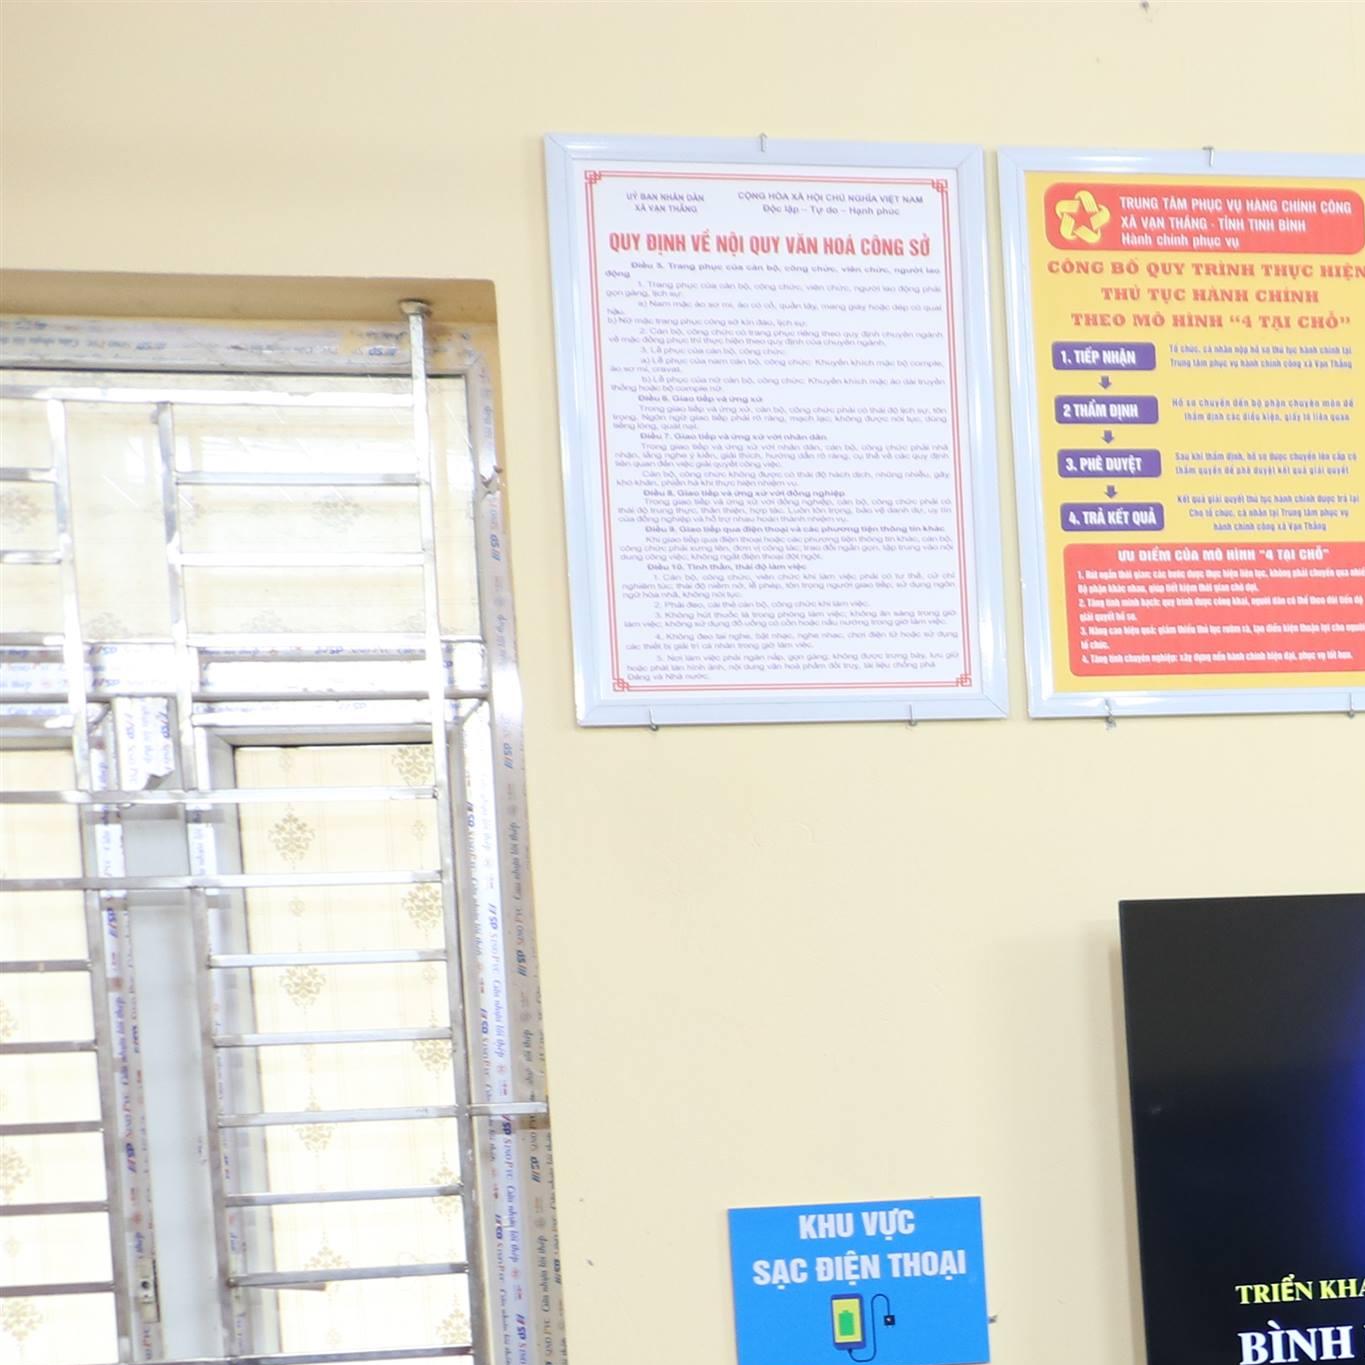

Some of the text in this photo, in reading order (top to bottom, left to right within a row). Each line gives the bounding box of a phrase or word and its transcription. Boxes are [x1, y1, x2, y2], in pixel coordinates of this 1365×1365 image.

[1119, 196, 1159, 211] TRUNG
[1162, 195, 1188, 211] TÂM
[1191, 198, 1223, 213] PHỤC
[1226, 198, 1243, 214] VỤ
[1281, 199, 1317, 214] CHÍNH
[1320, 199, 1352, 215] CÔNG
[609, 228, 930, 257] QUY ĐỊNH VỀ NỘI QUY VĂN HOÁ CÔNG SỞ
[1120, 233, 1240, 249] Hành chính phục vụ
[1047, 257, 1104, 275] CÔNG
[1110, 257, 1140, 275] BỐ
[1146, 261, 1185, 279] QUY
[1191, 260, 1255, 277] TRÌNH
[1260, 263, 1313, 281] THỰC
[1100, 284, 1319, 305] THỦ TỤC HÀNH CHÍNH
[1070, 312, 1126, 327] THEO
[1132, 311, 1166, 328] MÔ
[1172, 311, 1224, 329] HÌNH
[1258, 315, 1291, 332] TẠI
[1073, 346, 1100, 365] TIẾP
[1102, 347, 1136, 367] NHẬN
[1073, 398, 1108, 418] THẨM
[1109, 403, 1139, 421] ĐỊNH
[1079, 454, 1103, 472] PHÊ
[1105, 454, 1142, 474] DUYỆT
[1082, 507, 1106, 525] TRẢ
[1107, 507, 1130, 525] KẾT
[1132, 506, 1157, 527] QUẢ
[798, 1207, 916, 1241] KHU VỰC
[752, 1249, 967, 1291] SẠC ĐIỆN THOẠI
[1236, 1273, 1313, 1305] TRIỂN
